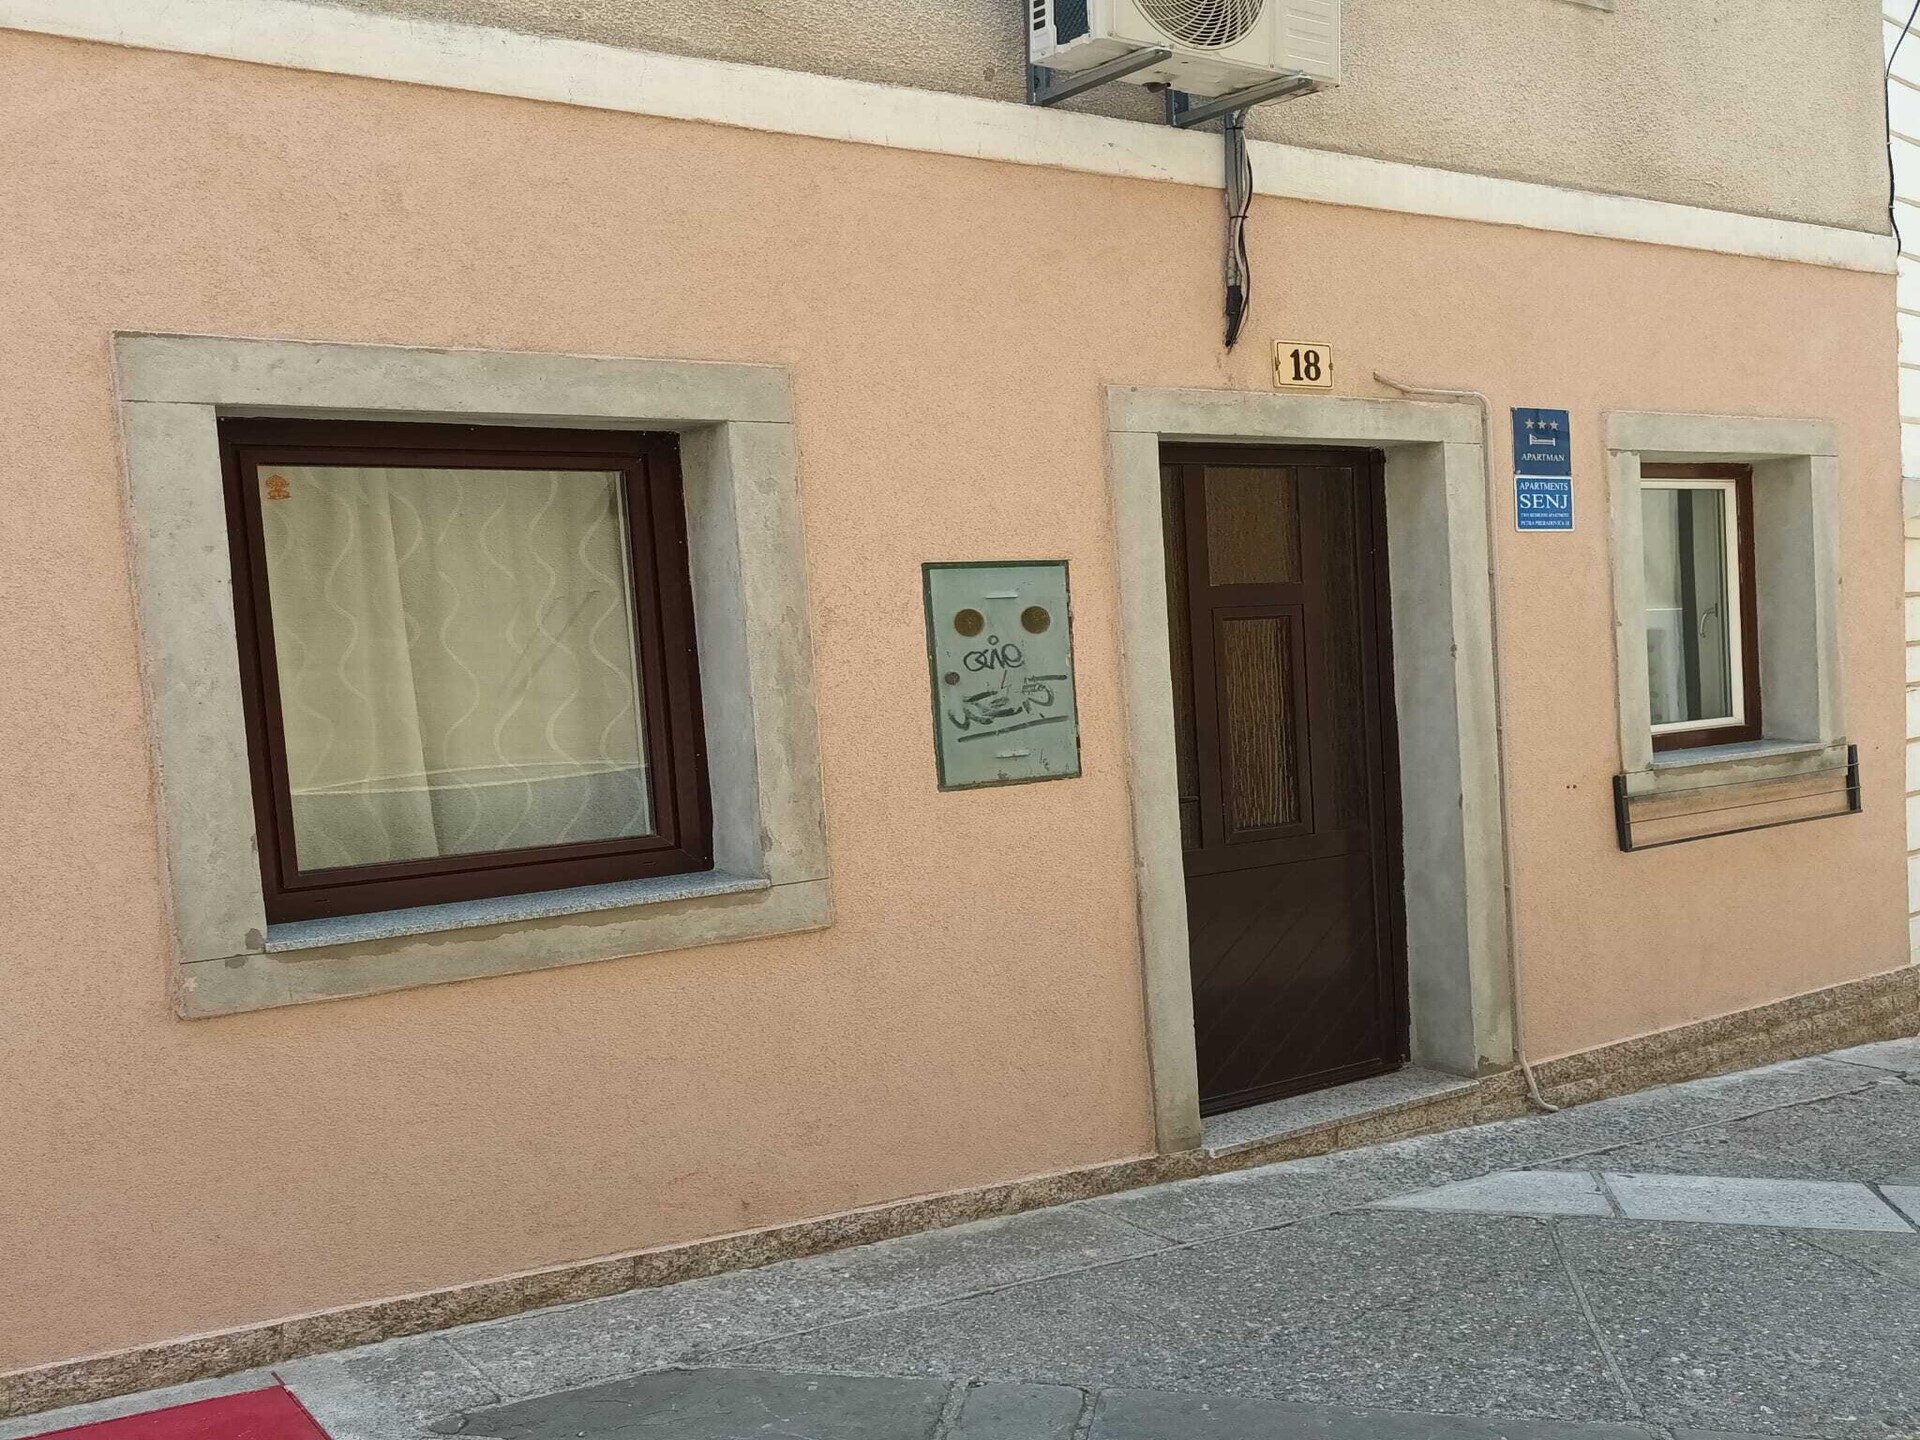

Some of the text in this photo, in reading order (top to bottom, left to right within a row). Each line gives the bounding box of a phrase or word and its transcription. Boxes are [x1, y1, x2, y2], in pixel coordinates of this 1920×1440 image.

[1290, 348, 1321, 381] 18
[1521, 453, 1565, 462] APARTMAN
[1519, 482, 1569, 491] APARTMENTS
[1519, 494, 1569, 509] SENJ
